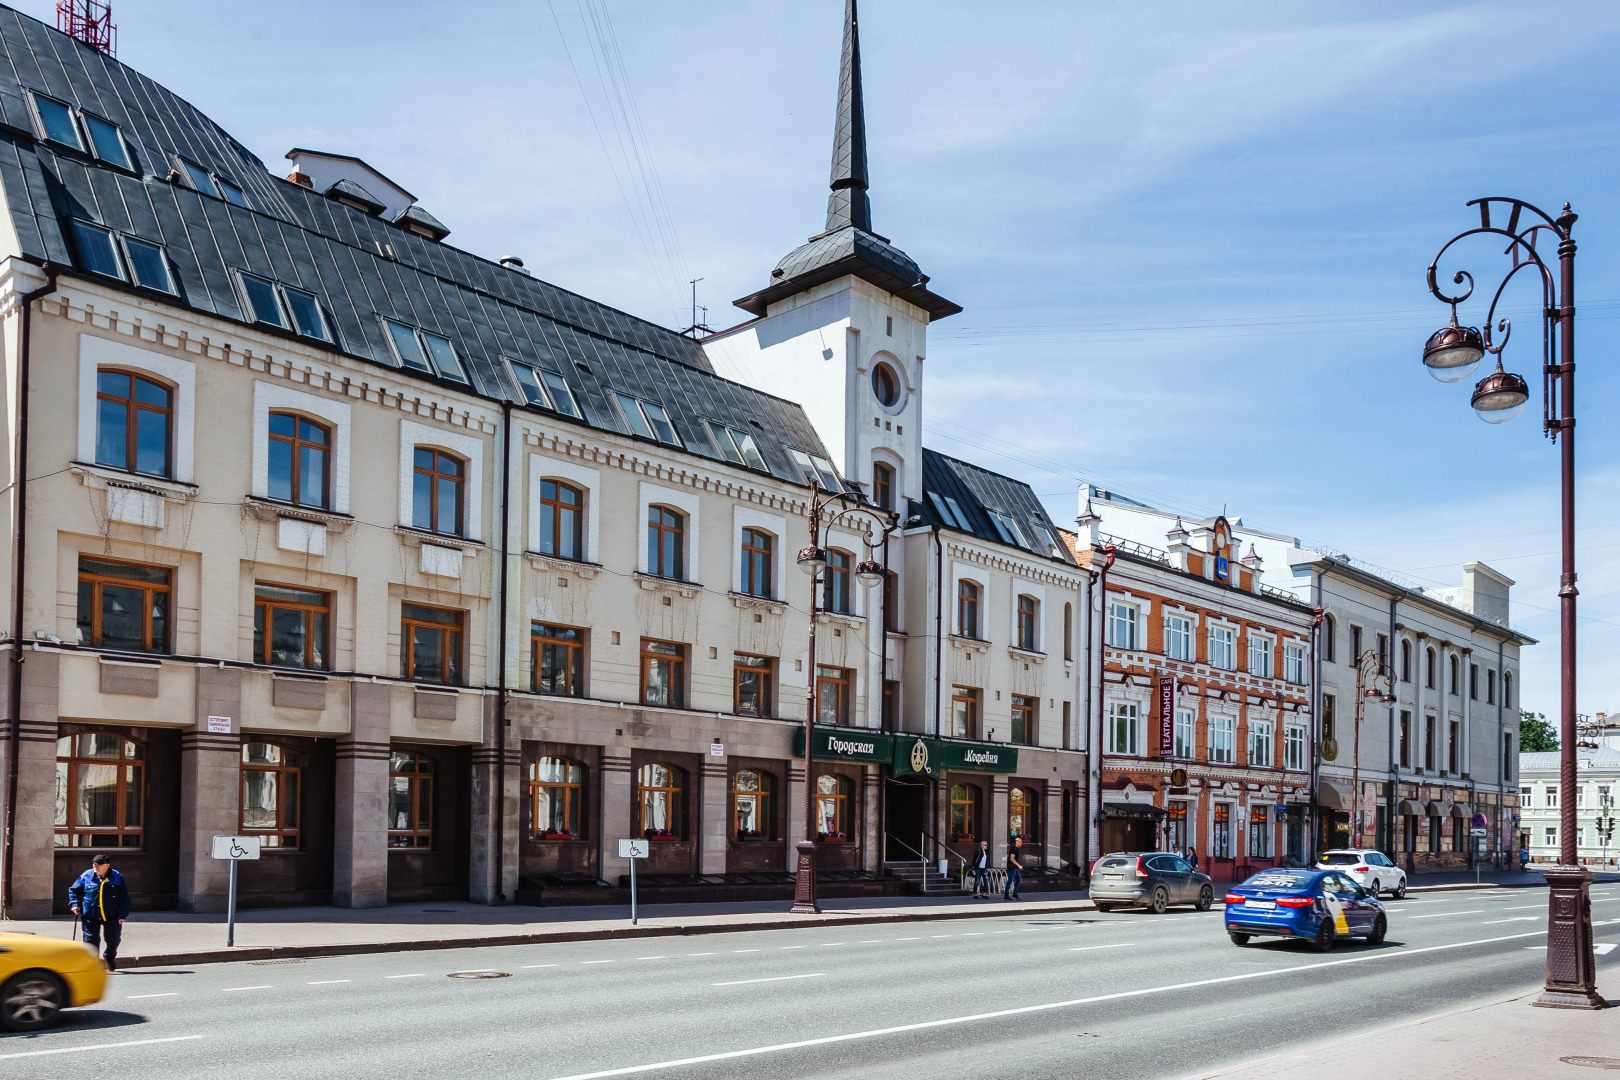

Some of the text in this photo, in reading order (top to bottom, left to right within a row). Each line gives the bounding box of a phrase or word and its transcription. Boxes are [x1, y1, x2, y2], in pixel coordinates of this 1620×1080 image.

[1163, 686, 1171, 748] ТЕАТРАЛЬНОЕ
[828, 736, 874, 754] Городская
[965, 749, 998, 765] Кофейня
